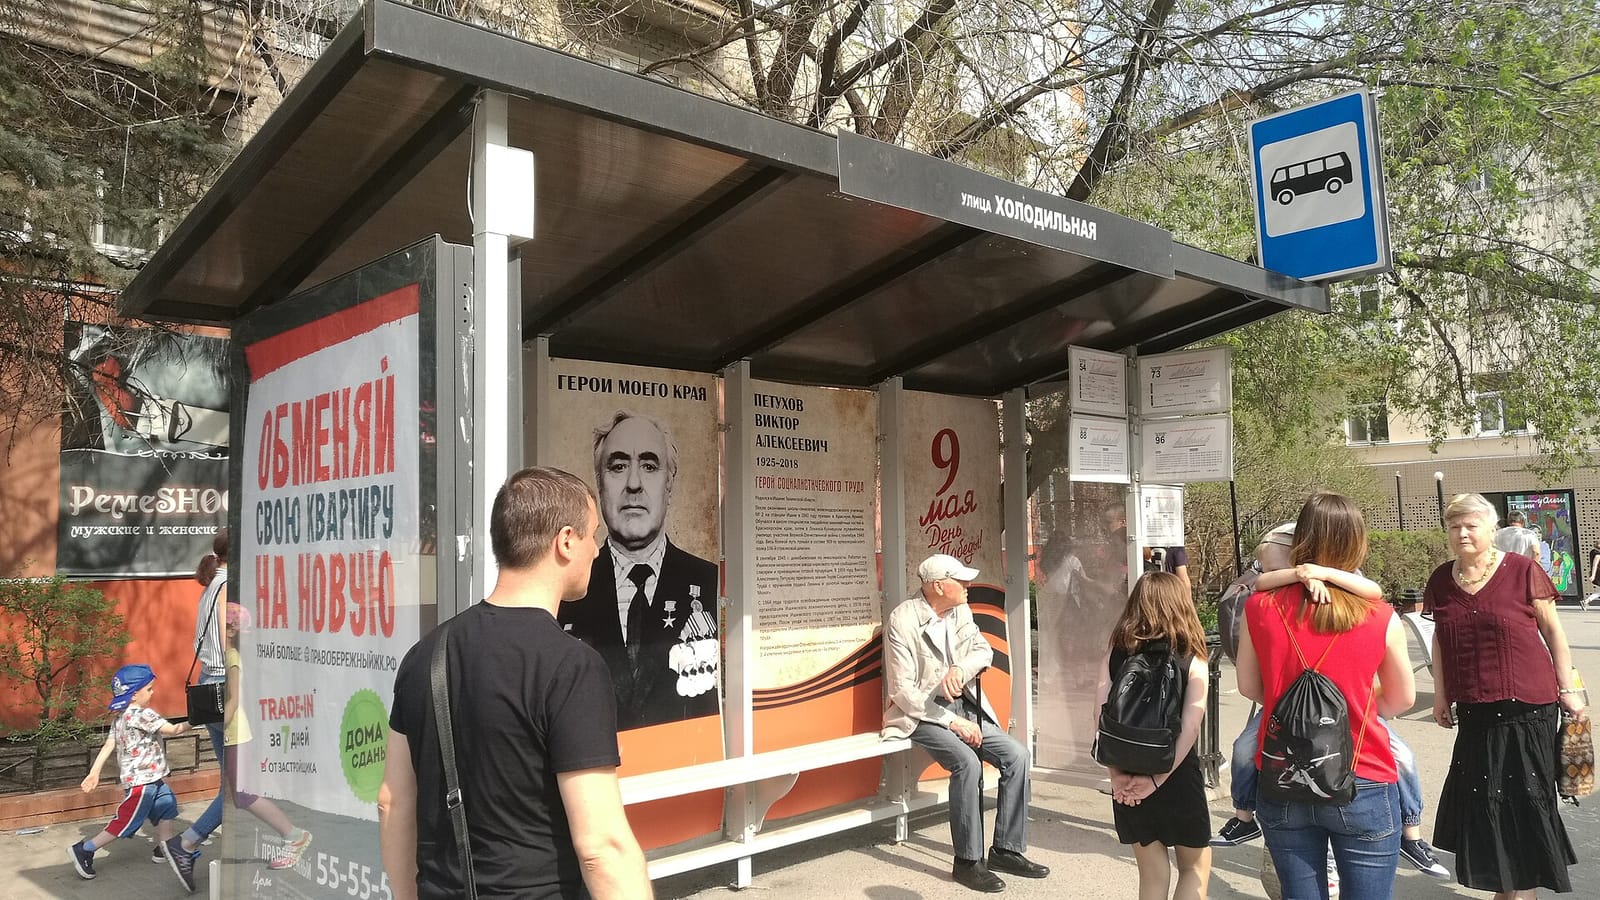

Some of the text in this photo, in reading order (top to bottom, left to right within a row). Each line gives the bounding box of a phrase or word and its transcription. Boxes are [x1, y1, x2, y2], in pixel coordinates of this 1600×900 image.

[961, 192, 1097, 240] УЛИЦА ХОЛОДИЛЬНАЯ
[1151, 370, 1161, 379] 73
[557, 374, 707, 401] ГЕРОИ МОЕГО КРАЯ
[754, 393, 804, 412] ПЕТУХОВ
[257, 355, 395, 491] ОБМЕНЯЙ
[755, 413, 800, 431] ВИКТОР
[755, 434, 828, 453] АЛЕКСЕЕВИЧ
[1155, 436, 1166, 444] 96
[756, 457, 799, 469] 1925-2018
[931, 428, 960, 497] 9
[755, 475, 865, 494] ГЕРОЙ СОЦИАЛИСТИЧЕСКОГО ТРУДА
[256, 484, 394, 546] СВОЮ КВАРТИРУ
[919, 490, 977, 527] мая
[71, 525, 218, 538] мужские и женские
[925, 524, 962, 548] День
[256, 550, 396, 638] НА НОВУЮ
[270, 725, 310, 753] за 7 дней
[345, 721, 383, 752] ДОМА
[268, 765, 278, 773] ОТ
